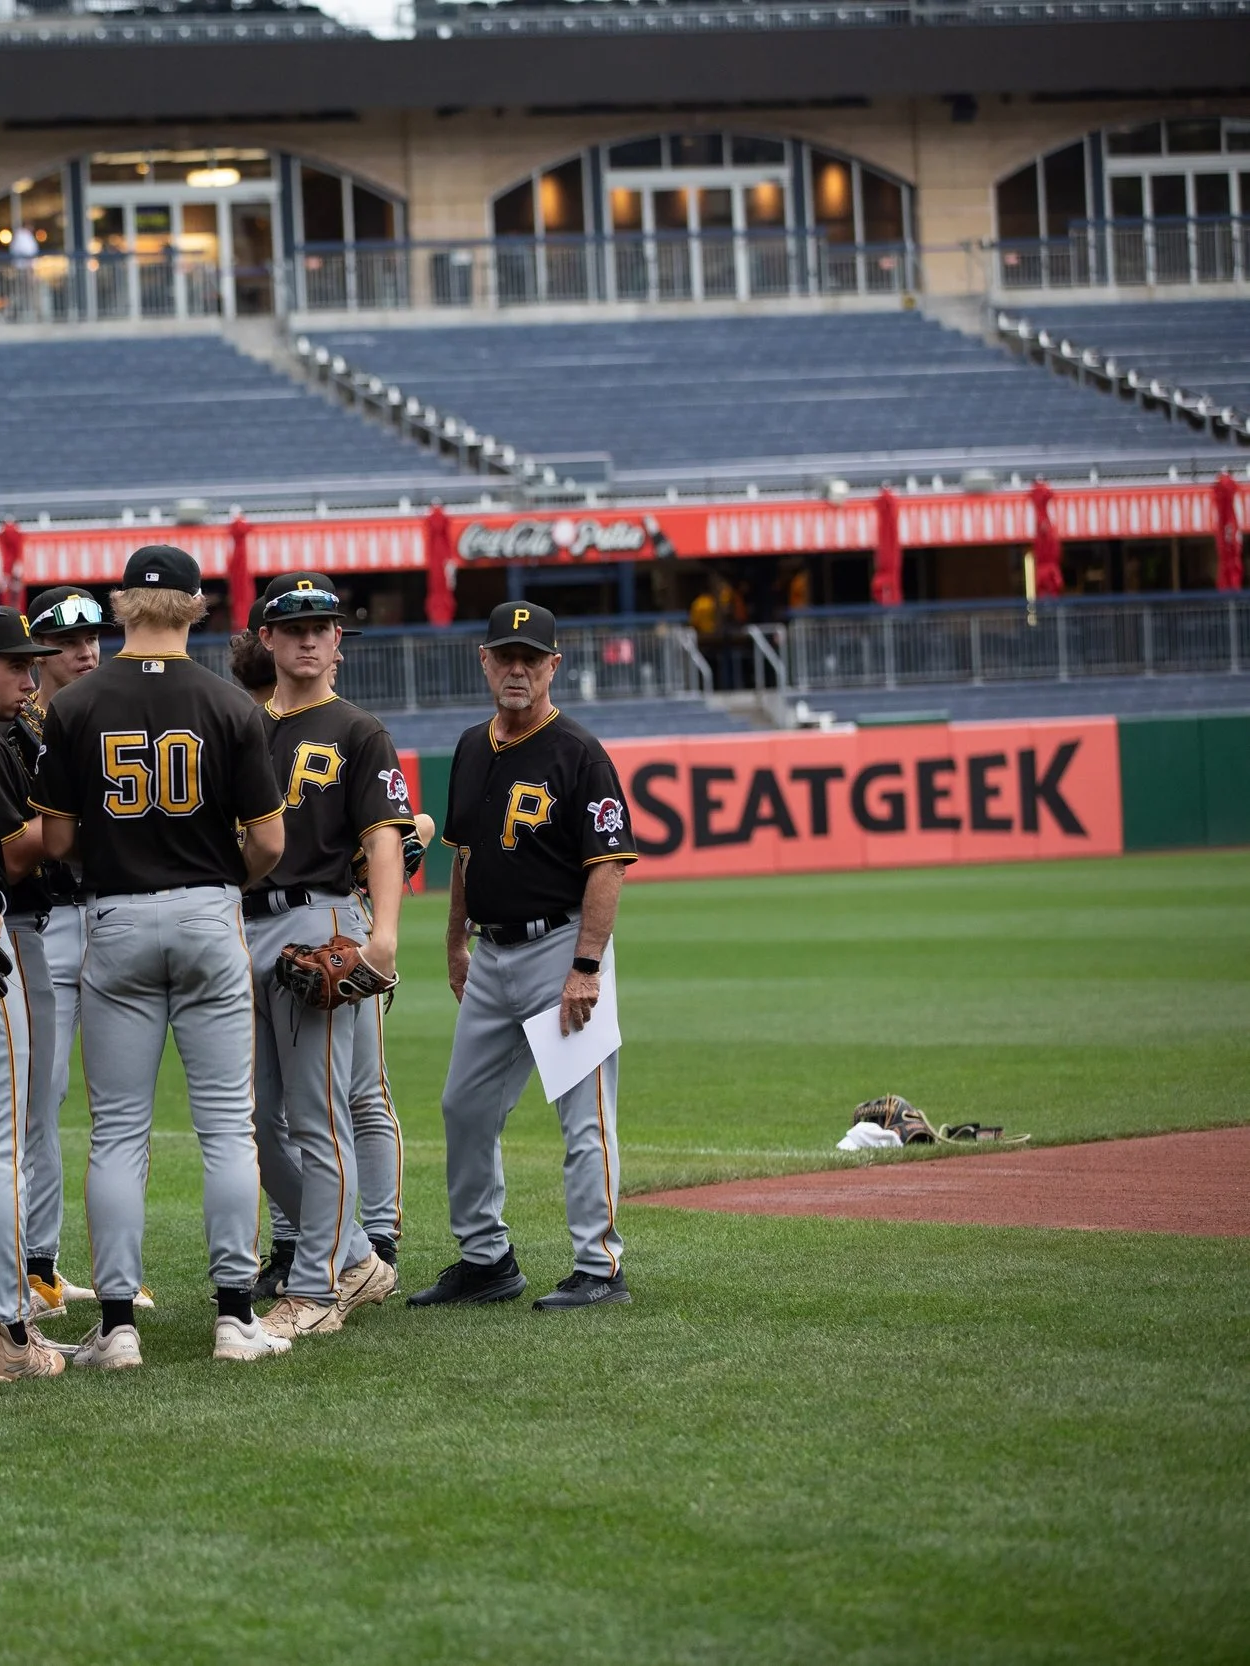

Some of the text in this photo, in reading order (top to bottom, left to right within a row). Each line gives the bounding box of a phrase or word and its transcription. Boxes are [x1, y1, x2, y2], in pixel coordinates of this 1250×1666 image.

[513, 608, 530, 630] P
[100, 729, 205, 819] 50
[284, 741, 347, 809] P
[630, 737, 1089, 858] SEATGEEK
[500, 780, 558, 851] P
[586, 1283, 611, 1301] HOKA
